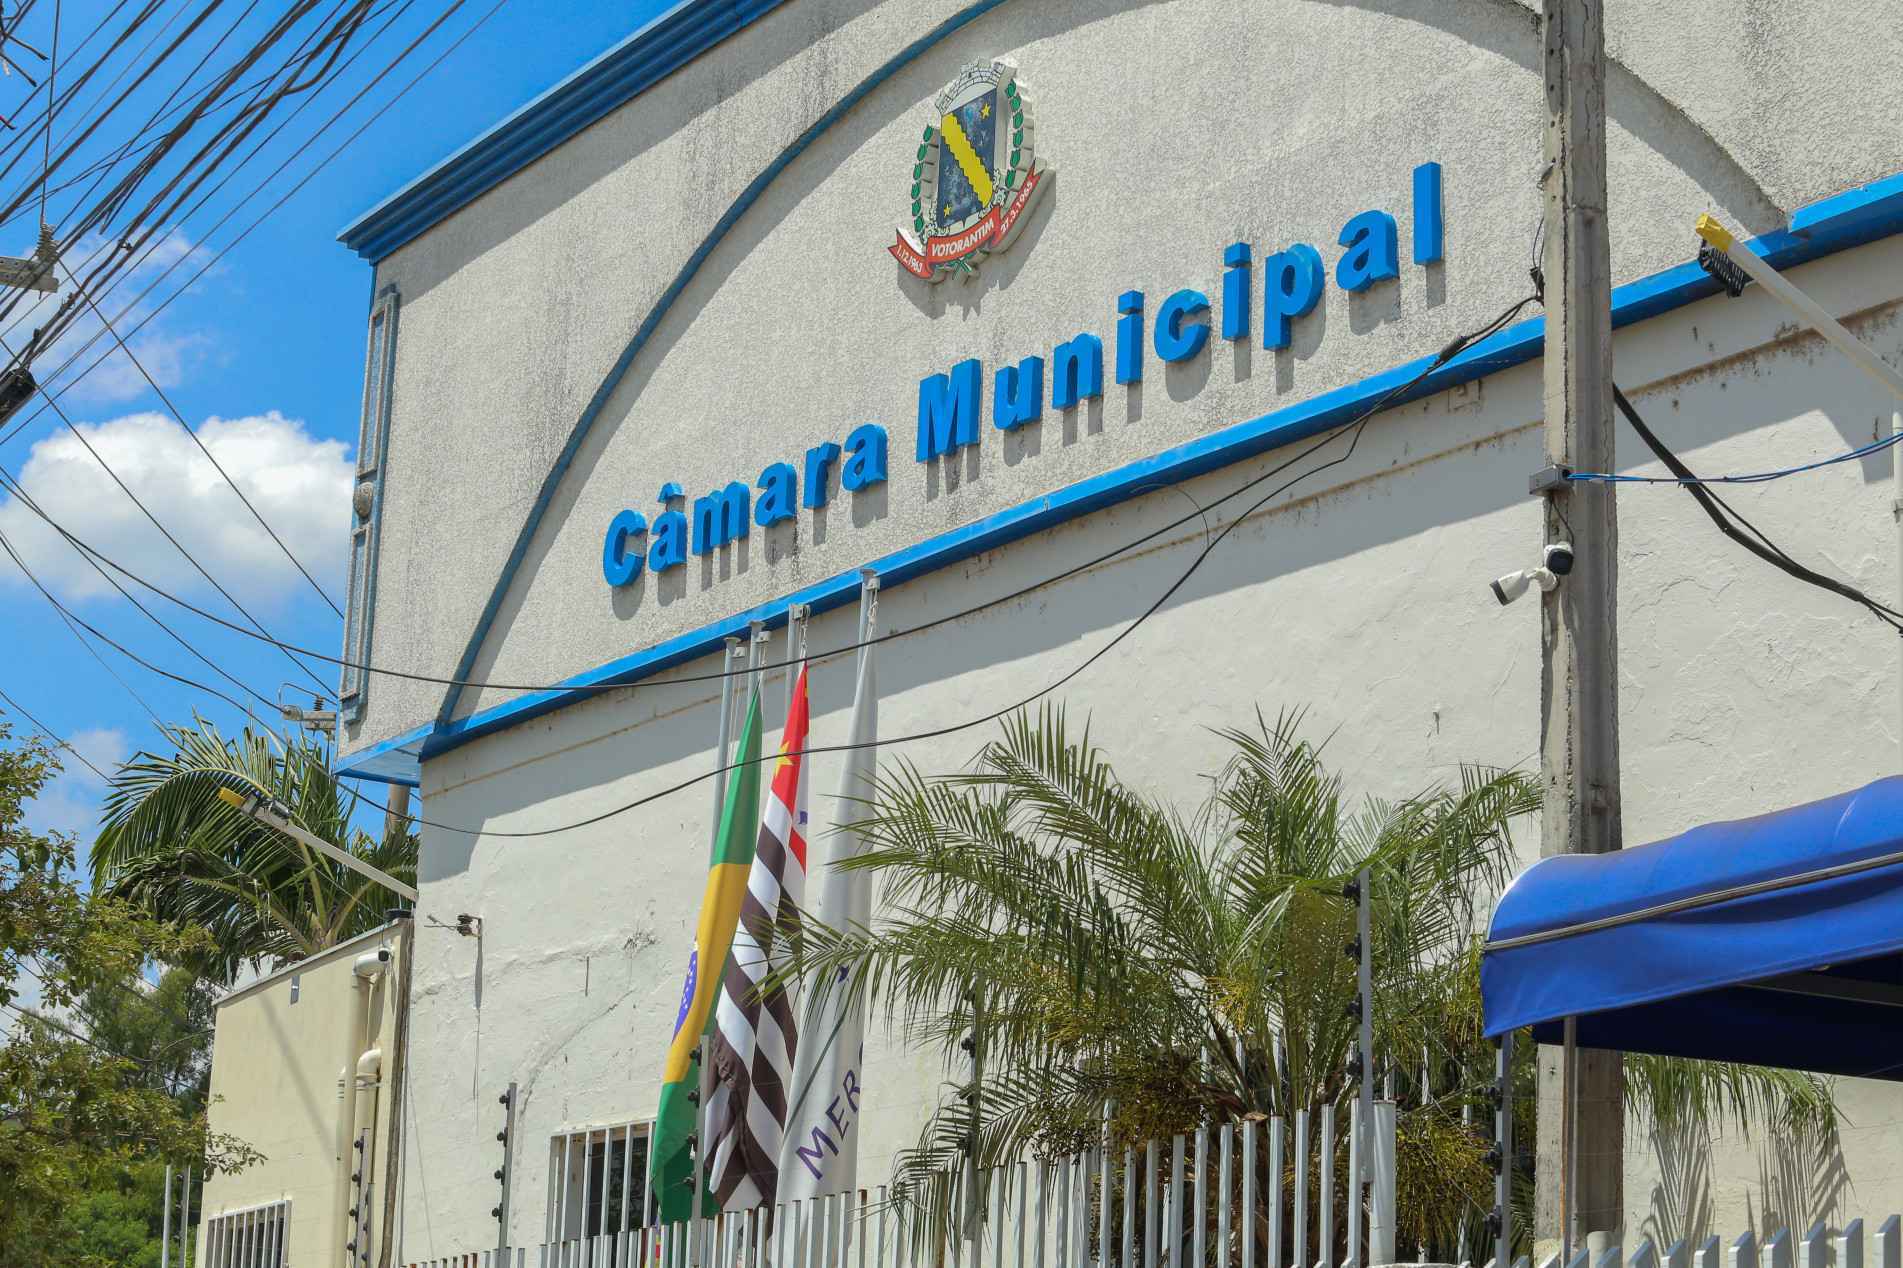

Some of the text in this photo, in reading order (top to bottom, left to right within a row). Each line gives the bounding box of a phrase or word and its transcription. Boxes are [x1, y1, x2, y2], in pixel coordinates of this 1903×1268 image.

[931, 217, 994, 256] VOTORANTIM
[603, 161, 1442, 587] Câmara Municipal
[796, 1041, 863, 1181] MER
